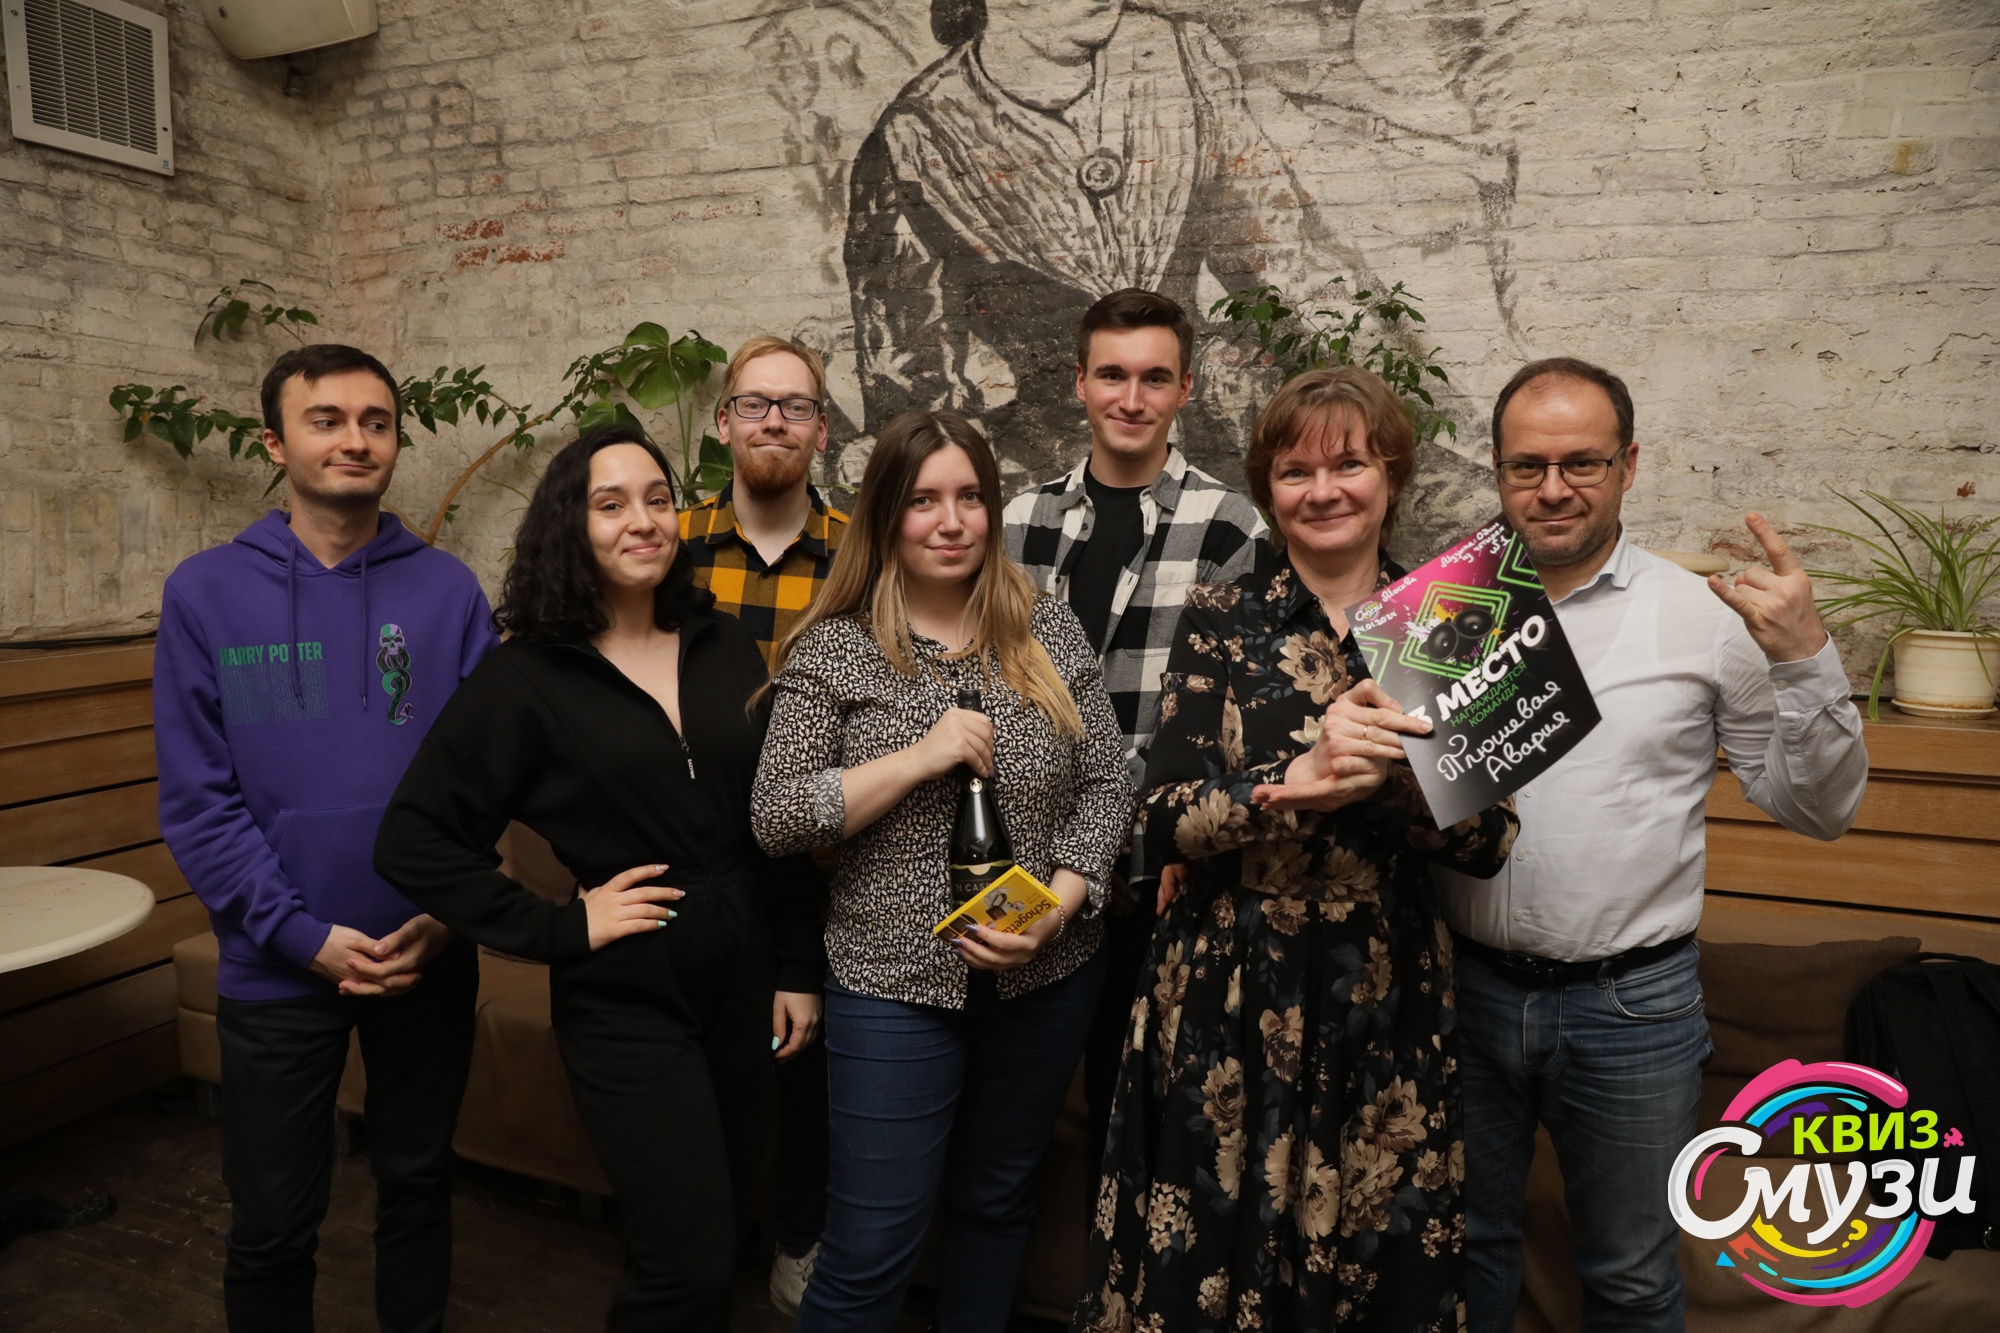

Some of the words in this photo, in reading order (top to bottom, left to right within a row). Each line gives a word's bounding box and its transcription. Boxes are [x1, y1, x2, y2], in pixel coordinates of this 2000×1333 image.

[1381, 577, 1417, 602] Москва
[1353, 611, 1397, 635] 24.01.2024
[219, 645, 264, 666] HARRY
[268, 641, 323, 663] POTER
[270, 661, 326, 682] POTER
[1435, 615, 1546, 722] МЕСТО
[1450, 661, 1527, 728] НАГРАЖДАЕТСЯ
[1468, 683, 1519, 728] КОМАНДА
[1437, 681, 1561, 781] Плюшевая
[1486, 711, 1570, 783] Авария
